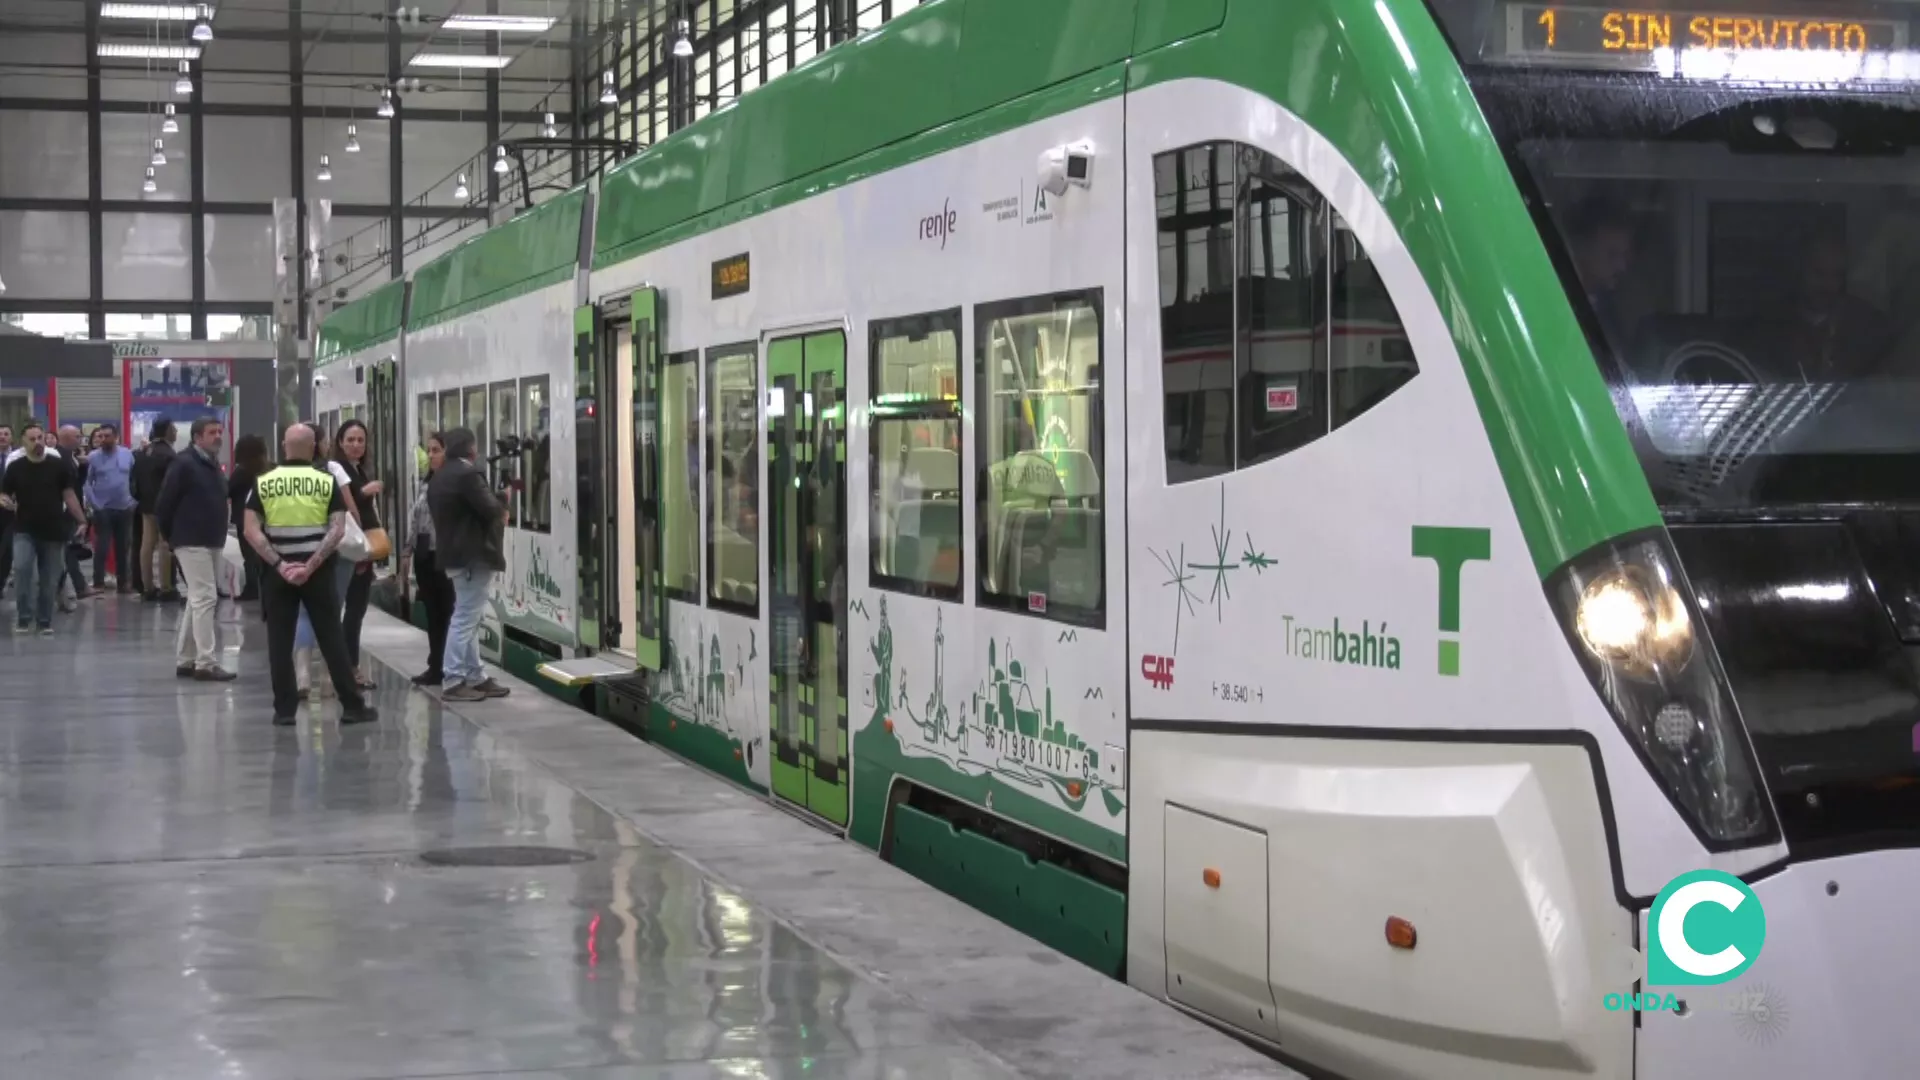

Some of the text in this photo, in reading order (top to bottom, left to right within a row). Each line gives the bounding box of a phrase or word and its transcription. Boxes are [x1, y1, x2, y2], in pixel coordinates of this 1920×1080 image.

[1538, 10, 1867, 53] 1 SIN SERVICIO
[919, 196, 957, 251] renfe
[260, 477, 331, 500] SEGURIDAD
[1282, 614, 1401, 671] Trambahía
[1141, 654, 1175, 691] CAF
[1220, 683, 1249, 704] 38.540
